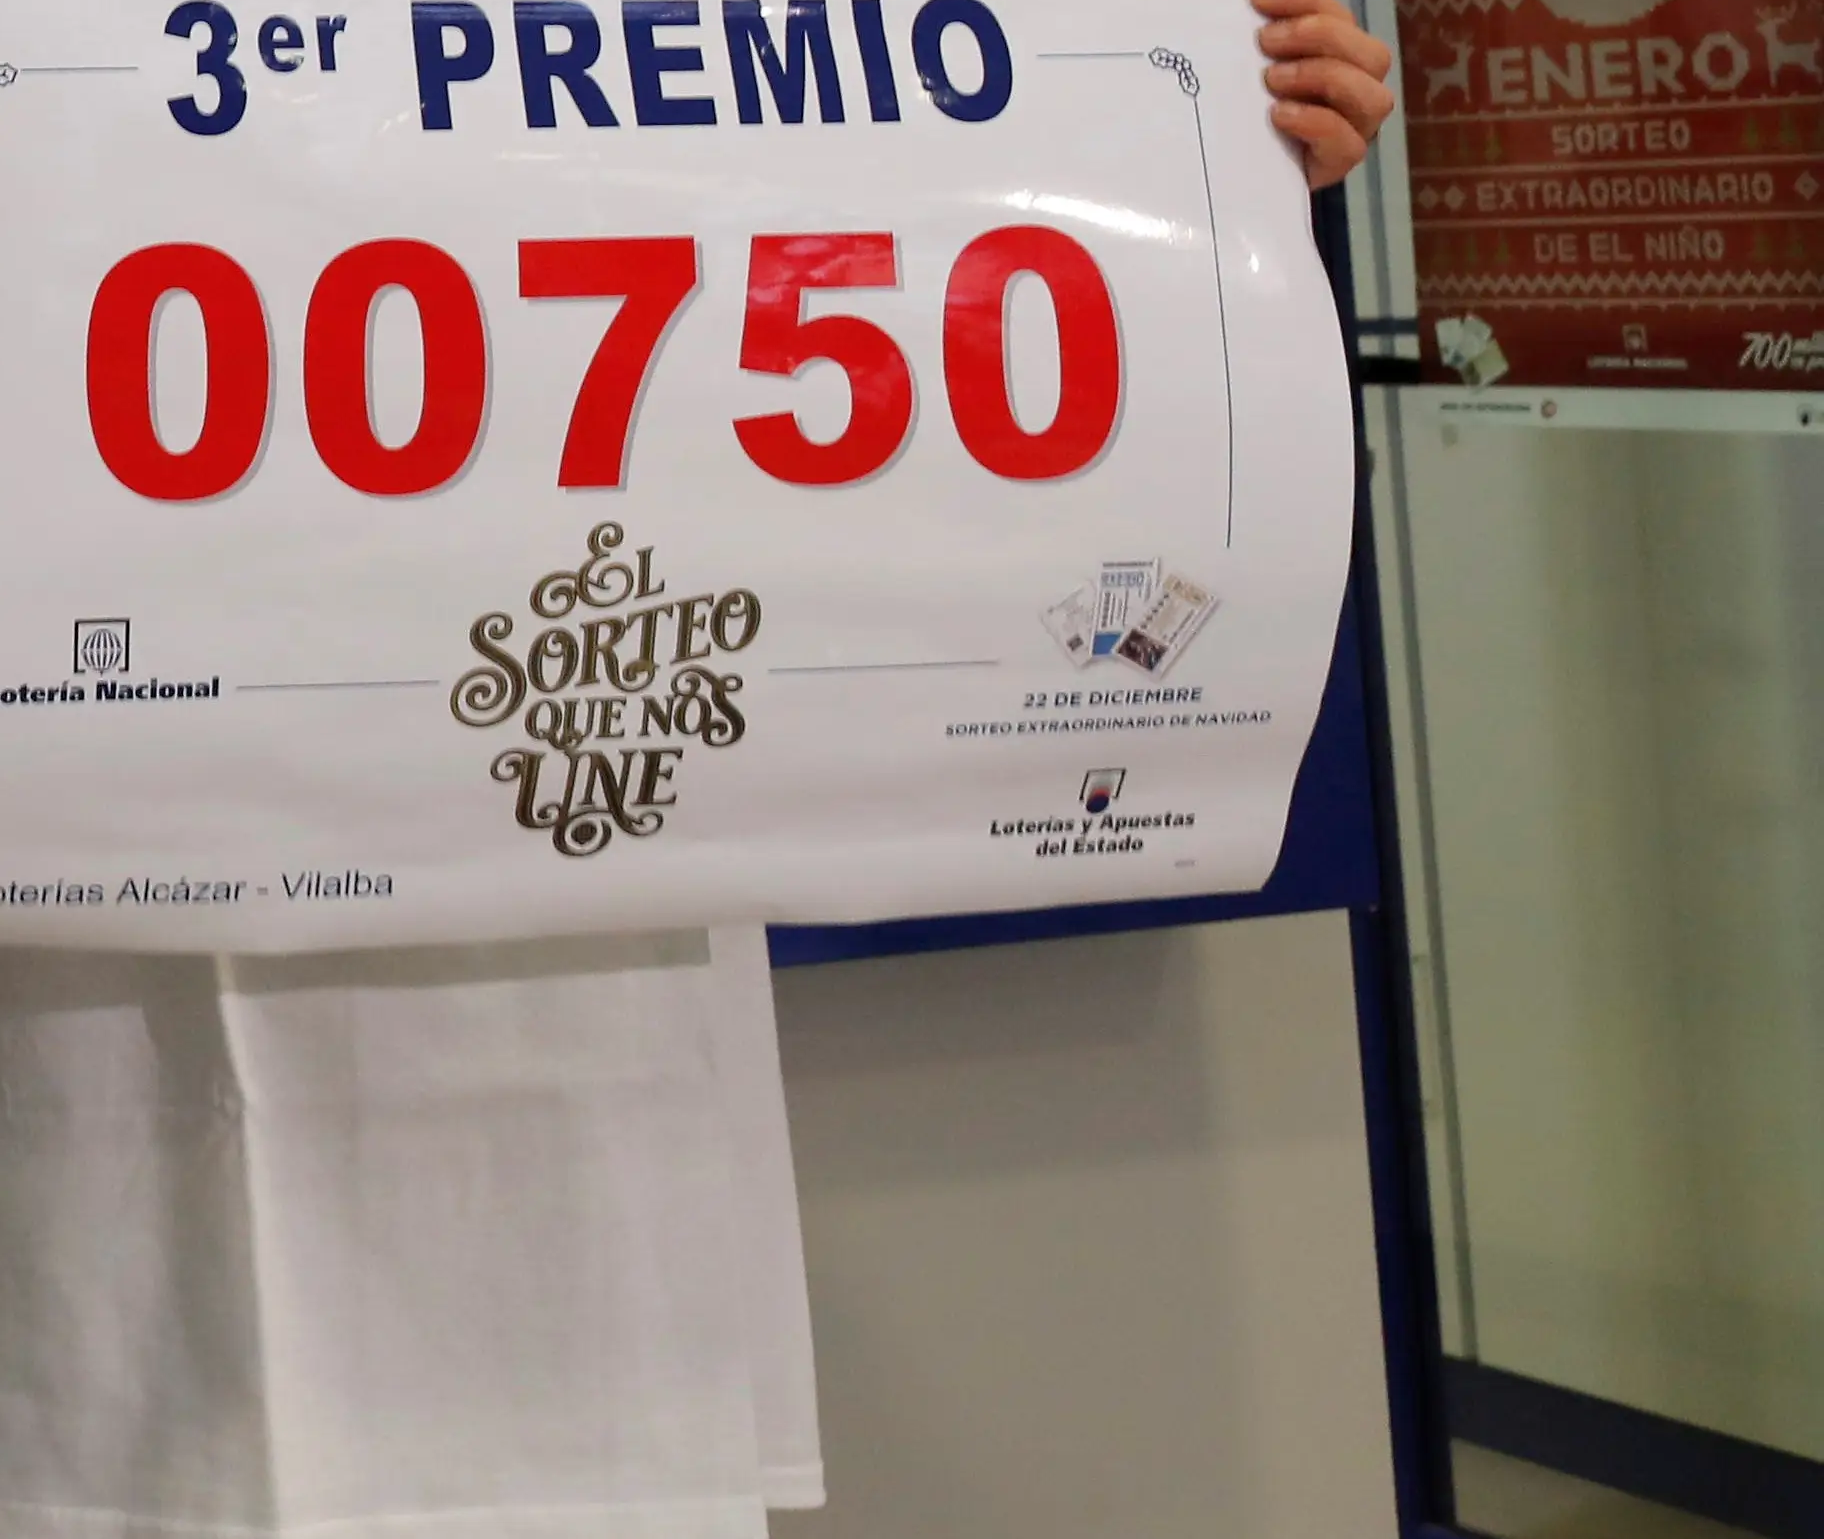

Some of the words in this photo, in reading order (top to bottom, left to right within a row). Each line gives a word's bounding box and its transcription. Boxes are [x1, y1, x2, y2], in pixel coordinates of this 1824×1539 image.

[1485, 31, 1750, 105] ENERO
[1552, 119, 1692, 155] SORTEO
[1475, 171, 1774, 212] EXTRAORDINARIO
[1534, 232, 1579, 264] DE
[1588, 230, 1633, 262] EL
[1644, 223, 1725, 262] NIÑO
[85, 221, 1126, 503] 00750
[1738, 331, 1793, 370] 700
[529, 519, 666, 620] EL
[449, 586, 762, 728] SORTEO
[95, 676, 220, 702] Nacional
[524, 694, 628, 751] QUE
[637, 663, 747, 748] NOS
[1023, 692, 1048, 709] 22
[1054, 690, 1082, 708] DE
[1088, 686, 1204, 706] DICIEMBRE
[945, 722, 1012, 738] SORTEO
[1016, 715, 1165, 735] EXTRAORDINARIO
[1169, 713, 1192, 728] DE
[1194, 710, 1272, 726] NAVIDAD
[489, 746, 685, 858] UNE
[1081, 817, 1094, 839] y
[1099, 811, 1196, 836] Apuestas
[1035, 839, 1067, 858] del
[1071, 835, 1144, 855] Estado
[115, 875, 247, 906] Alcázar
[280, 868, 394, 902] Vilalba
